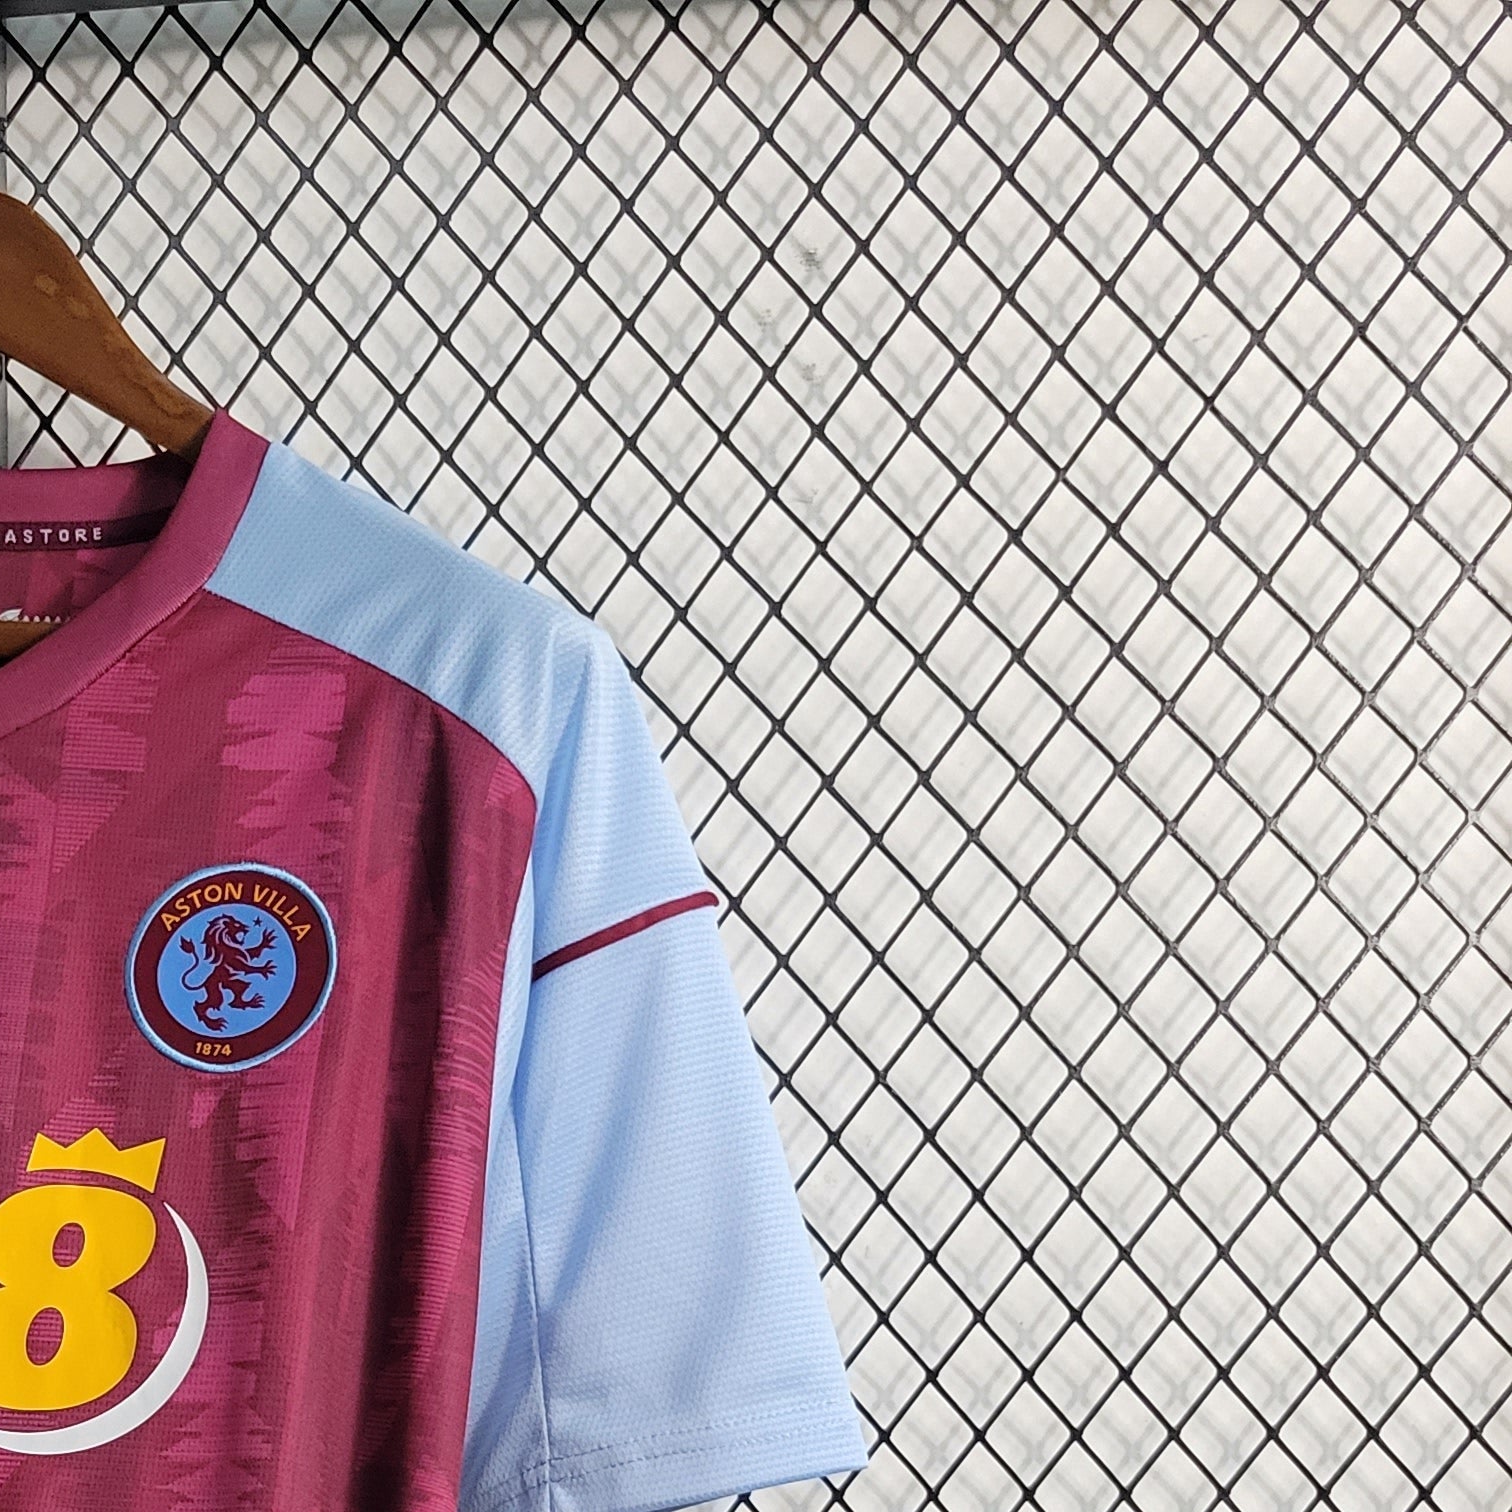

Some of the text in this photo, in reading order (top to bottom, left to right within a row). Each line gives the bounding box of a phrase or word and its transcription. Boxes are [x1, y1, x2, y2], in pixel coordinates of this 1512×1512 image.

[160, 882, 312, 942] ASTON VILLA
[195, 1041, 232, 1057] 1874
